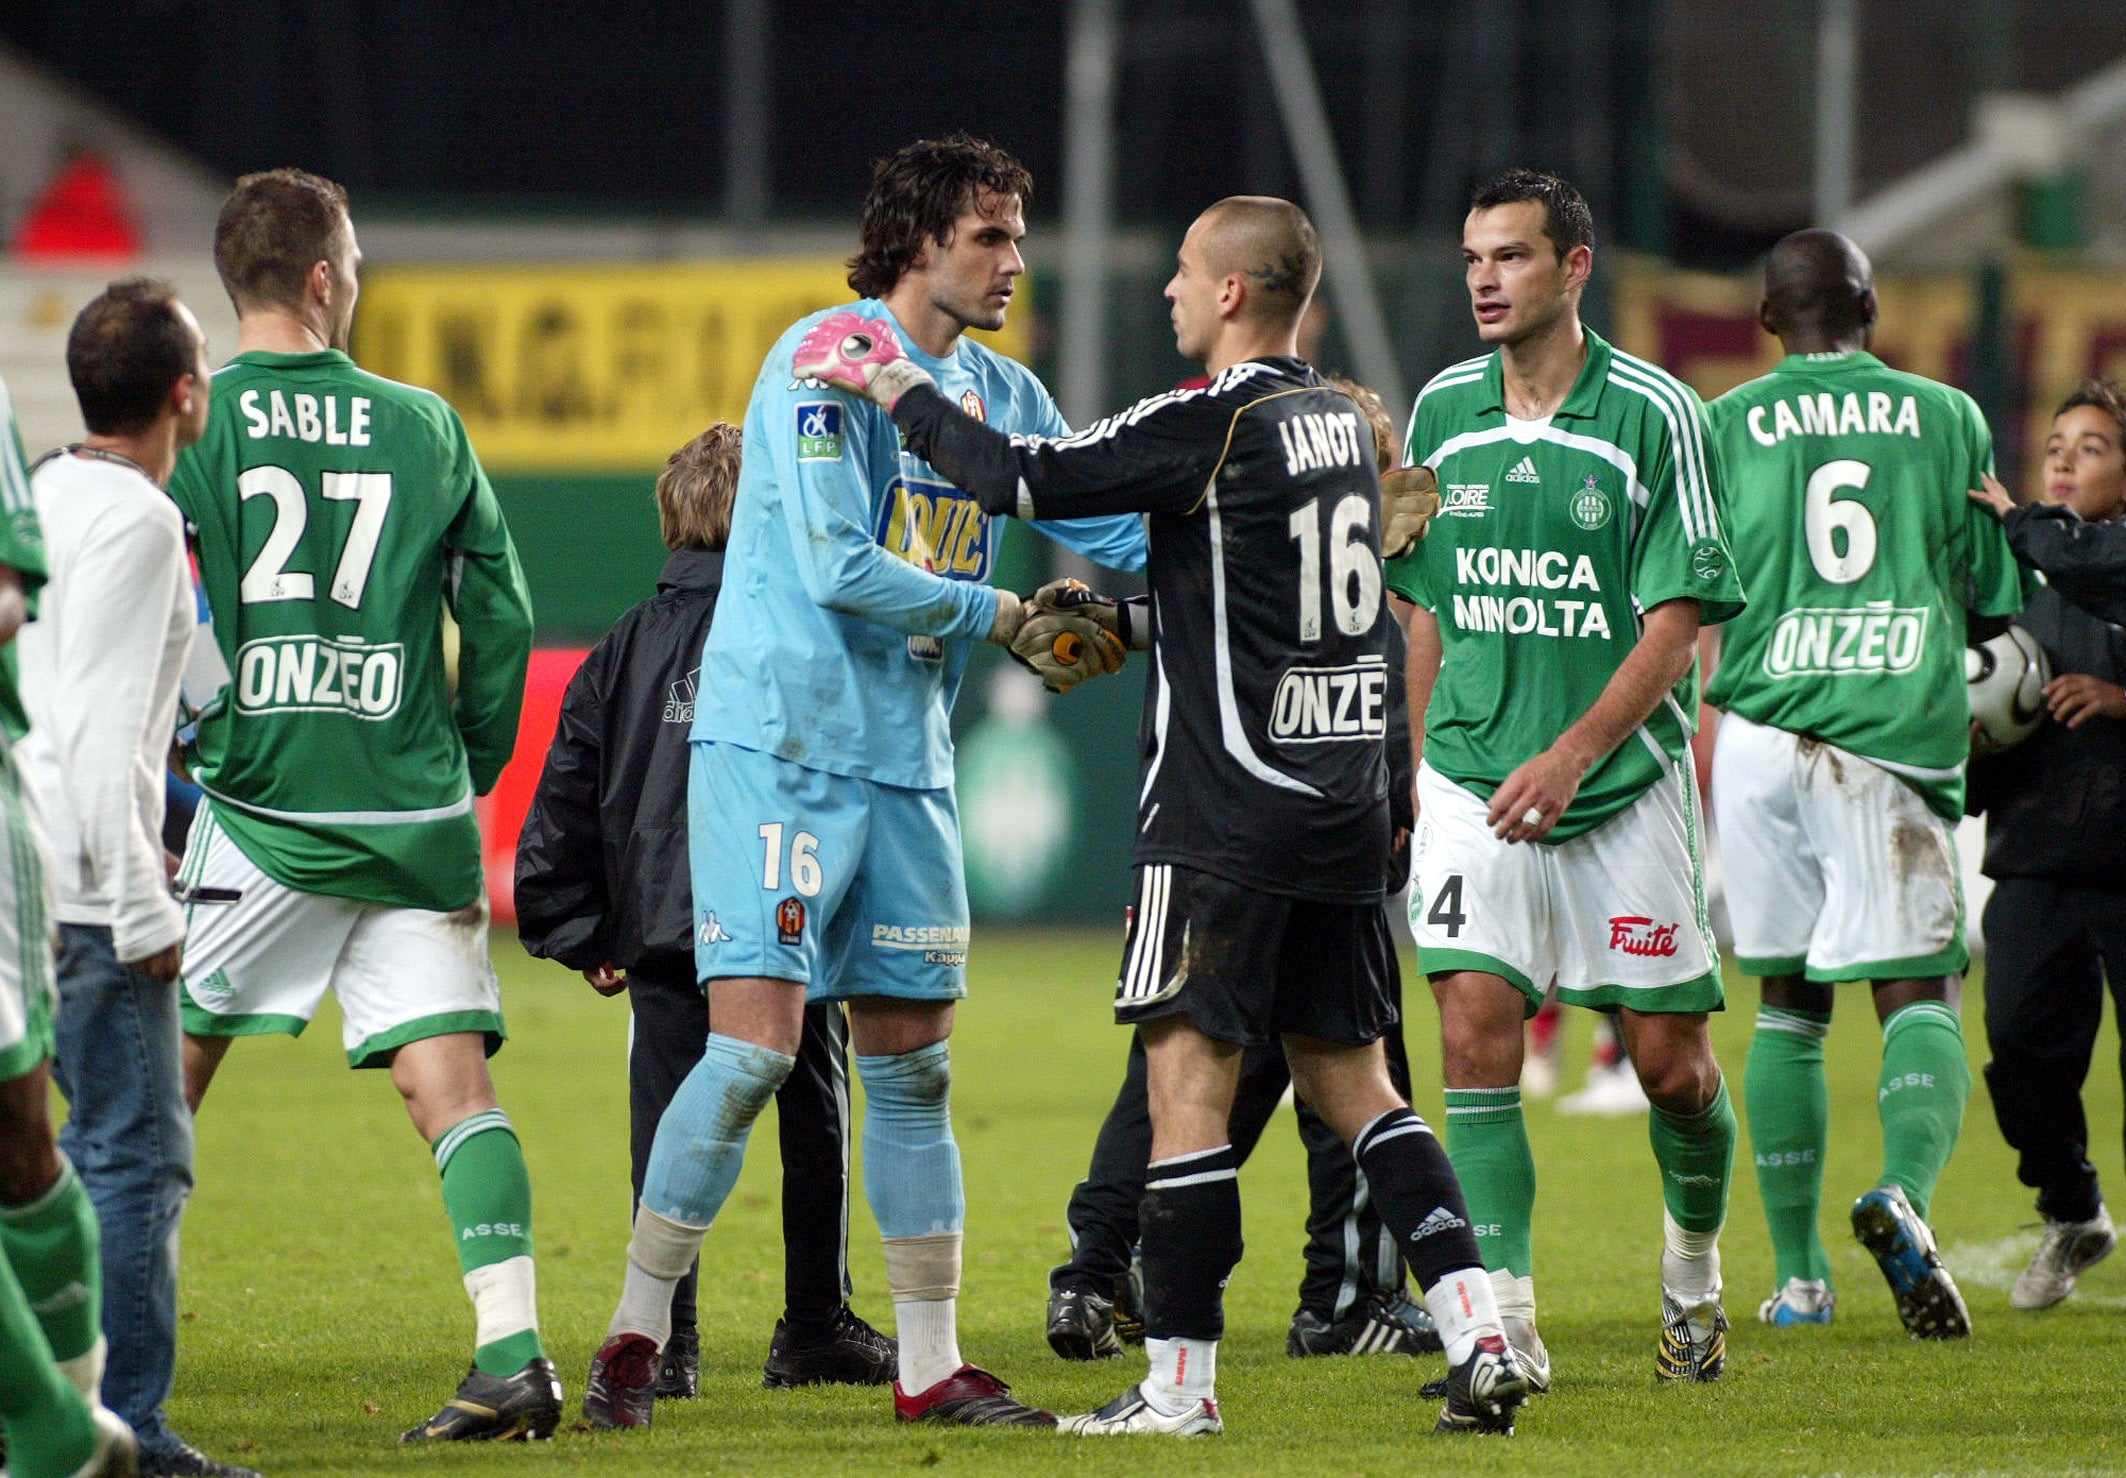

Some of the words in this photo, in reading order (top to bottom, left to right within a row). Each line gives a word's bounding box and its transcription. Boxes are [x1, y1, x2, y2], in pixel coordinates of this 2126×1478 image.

[239, 389, 371, 446] SABLE
[1746, 391, 1921, 447] CAMARA
[803, 441, 836, 453] LFP
[1278, 412, 1361, 476] JANOT
[1445, 489, 1489, 506] LOIRE
[237, 464, 392, 610] 27
[1804, 458, 1877, 584] 6
[1289, 494, 1382, 641] 16
[1455, 547, 1600, 592] KONICA
[1453, 594, 1611, 640] MINOLTA
[759, 821, 823, 898] 16
[1427, 874, 1466, 938] 4
[1608, 916, 1681, 957] Fruité
[1878, 1072, 1935, 1102] ASSE
[1756, 1149, 1816, 1167] ASSE
[462, 1223, 523, 1241] ASSE
[1410, 1218, 1466, 1241] adidas
[1472, 1223, 1502, 1237] SE
